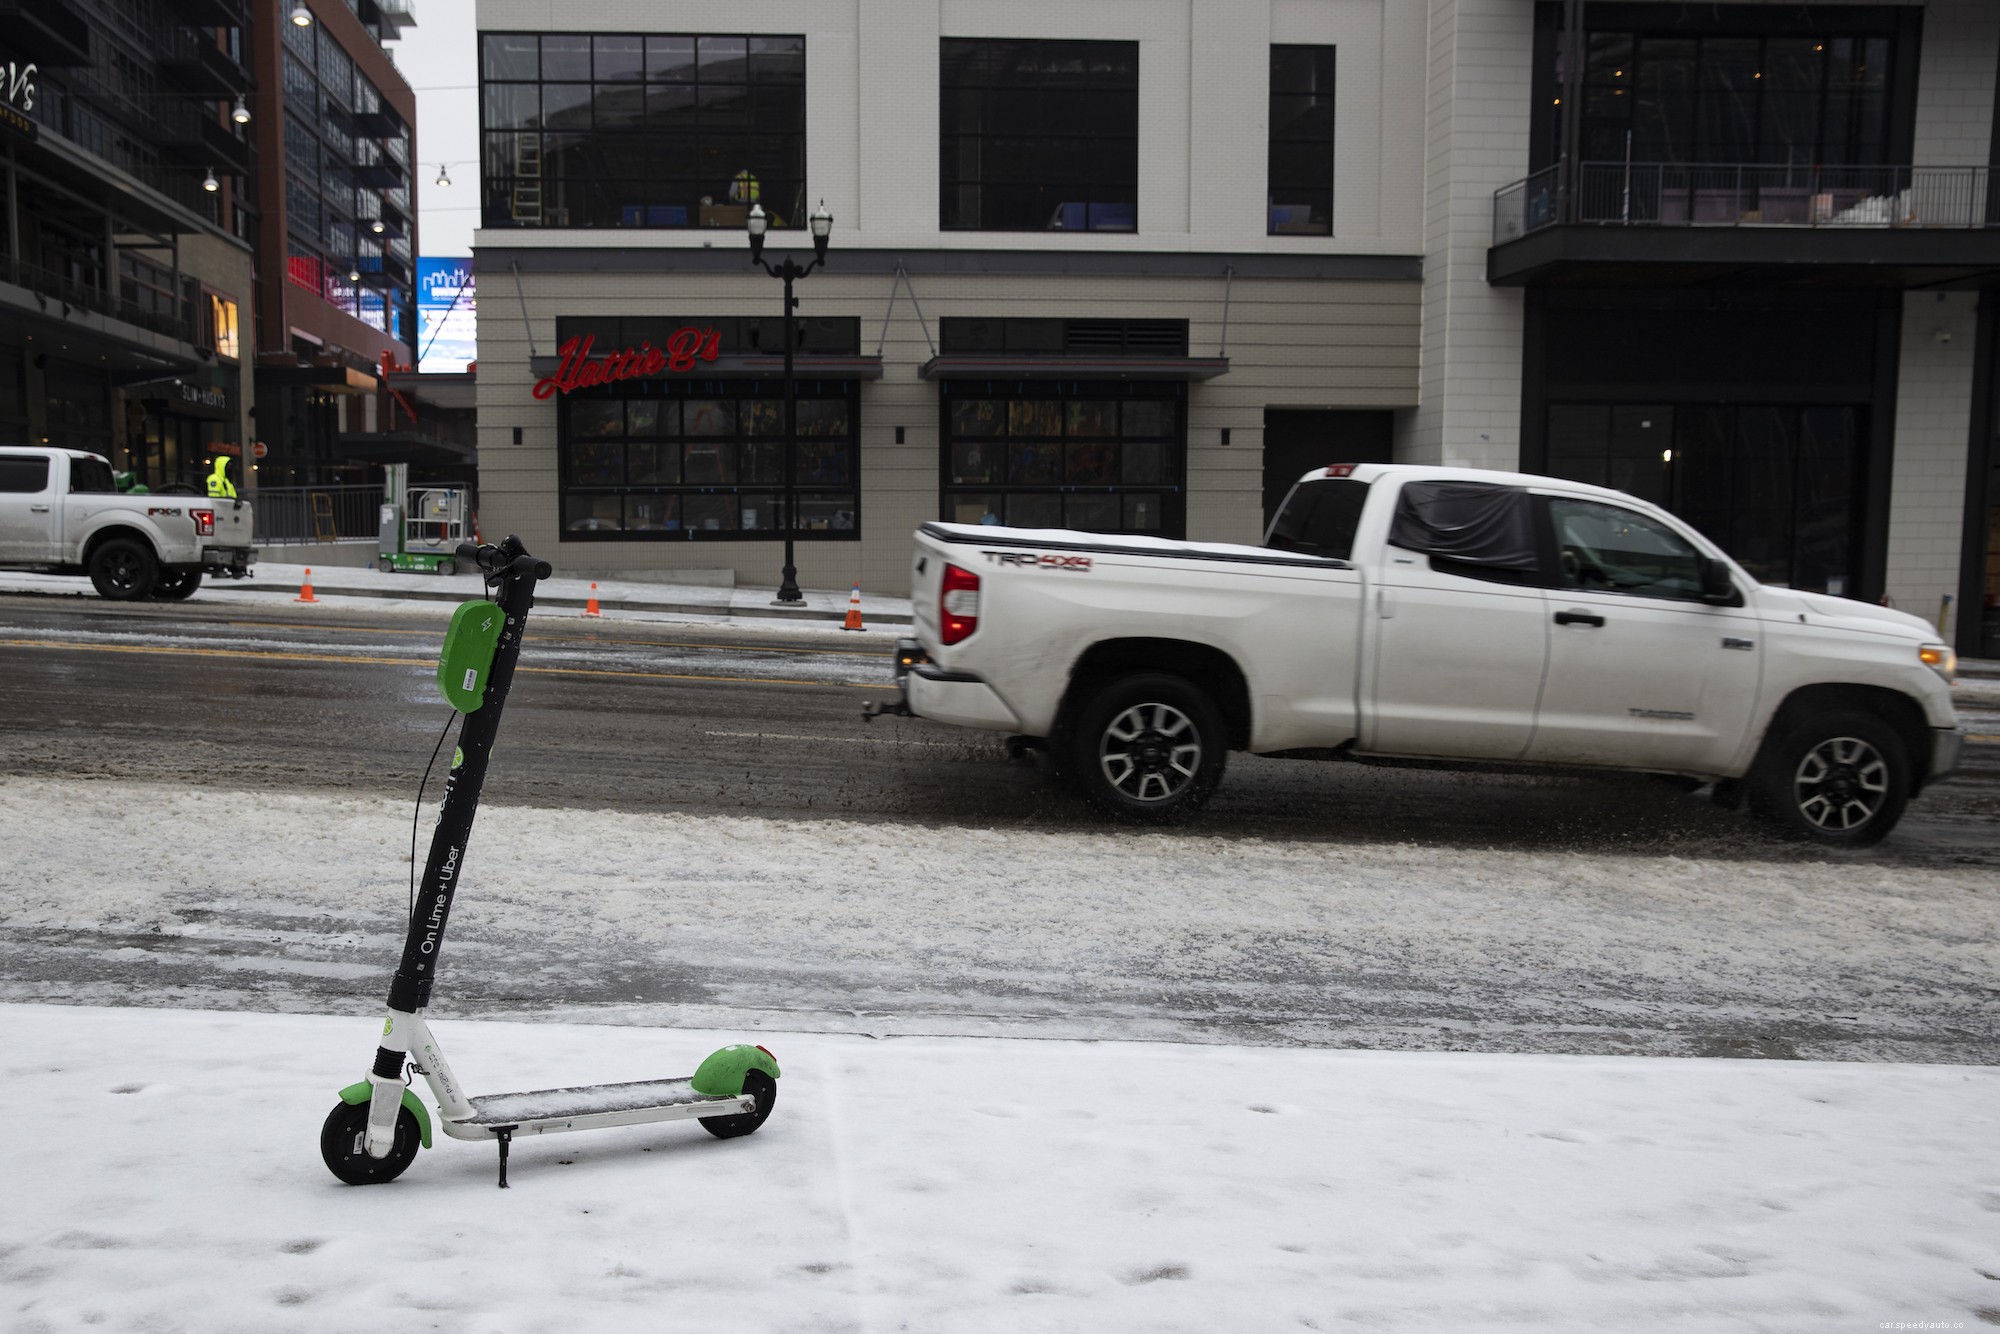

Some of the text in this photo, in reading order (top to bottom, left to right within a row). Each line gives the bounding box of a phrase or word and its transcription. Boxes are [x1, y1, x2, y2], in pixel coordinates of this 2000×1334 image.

[532, 326, 721, 400] Hattie B's
[439, 845, 460, 881] Uber
[439, 882, 448, 892] +
[426, 893, 447, 930] Lime
[421, 932, 437, 954] On
